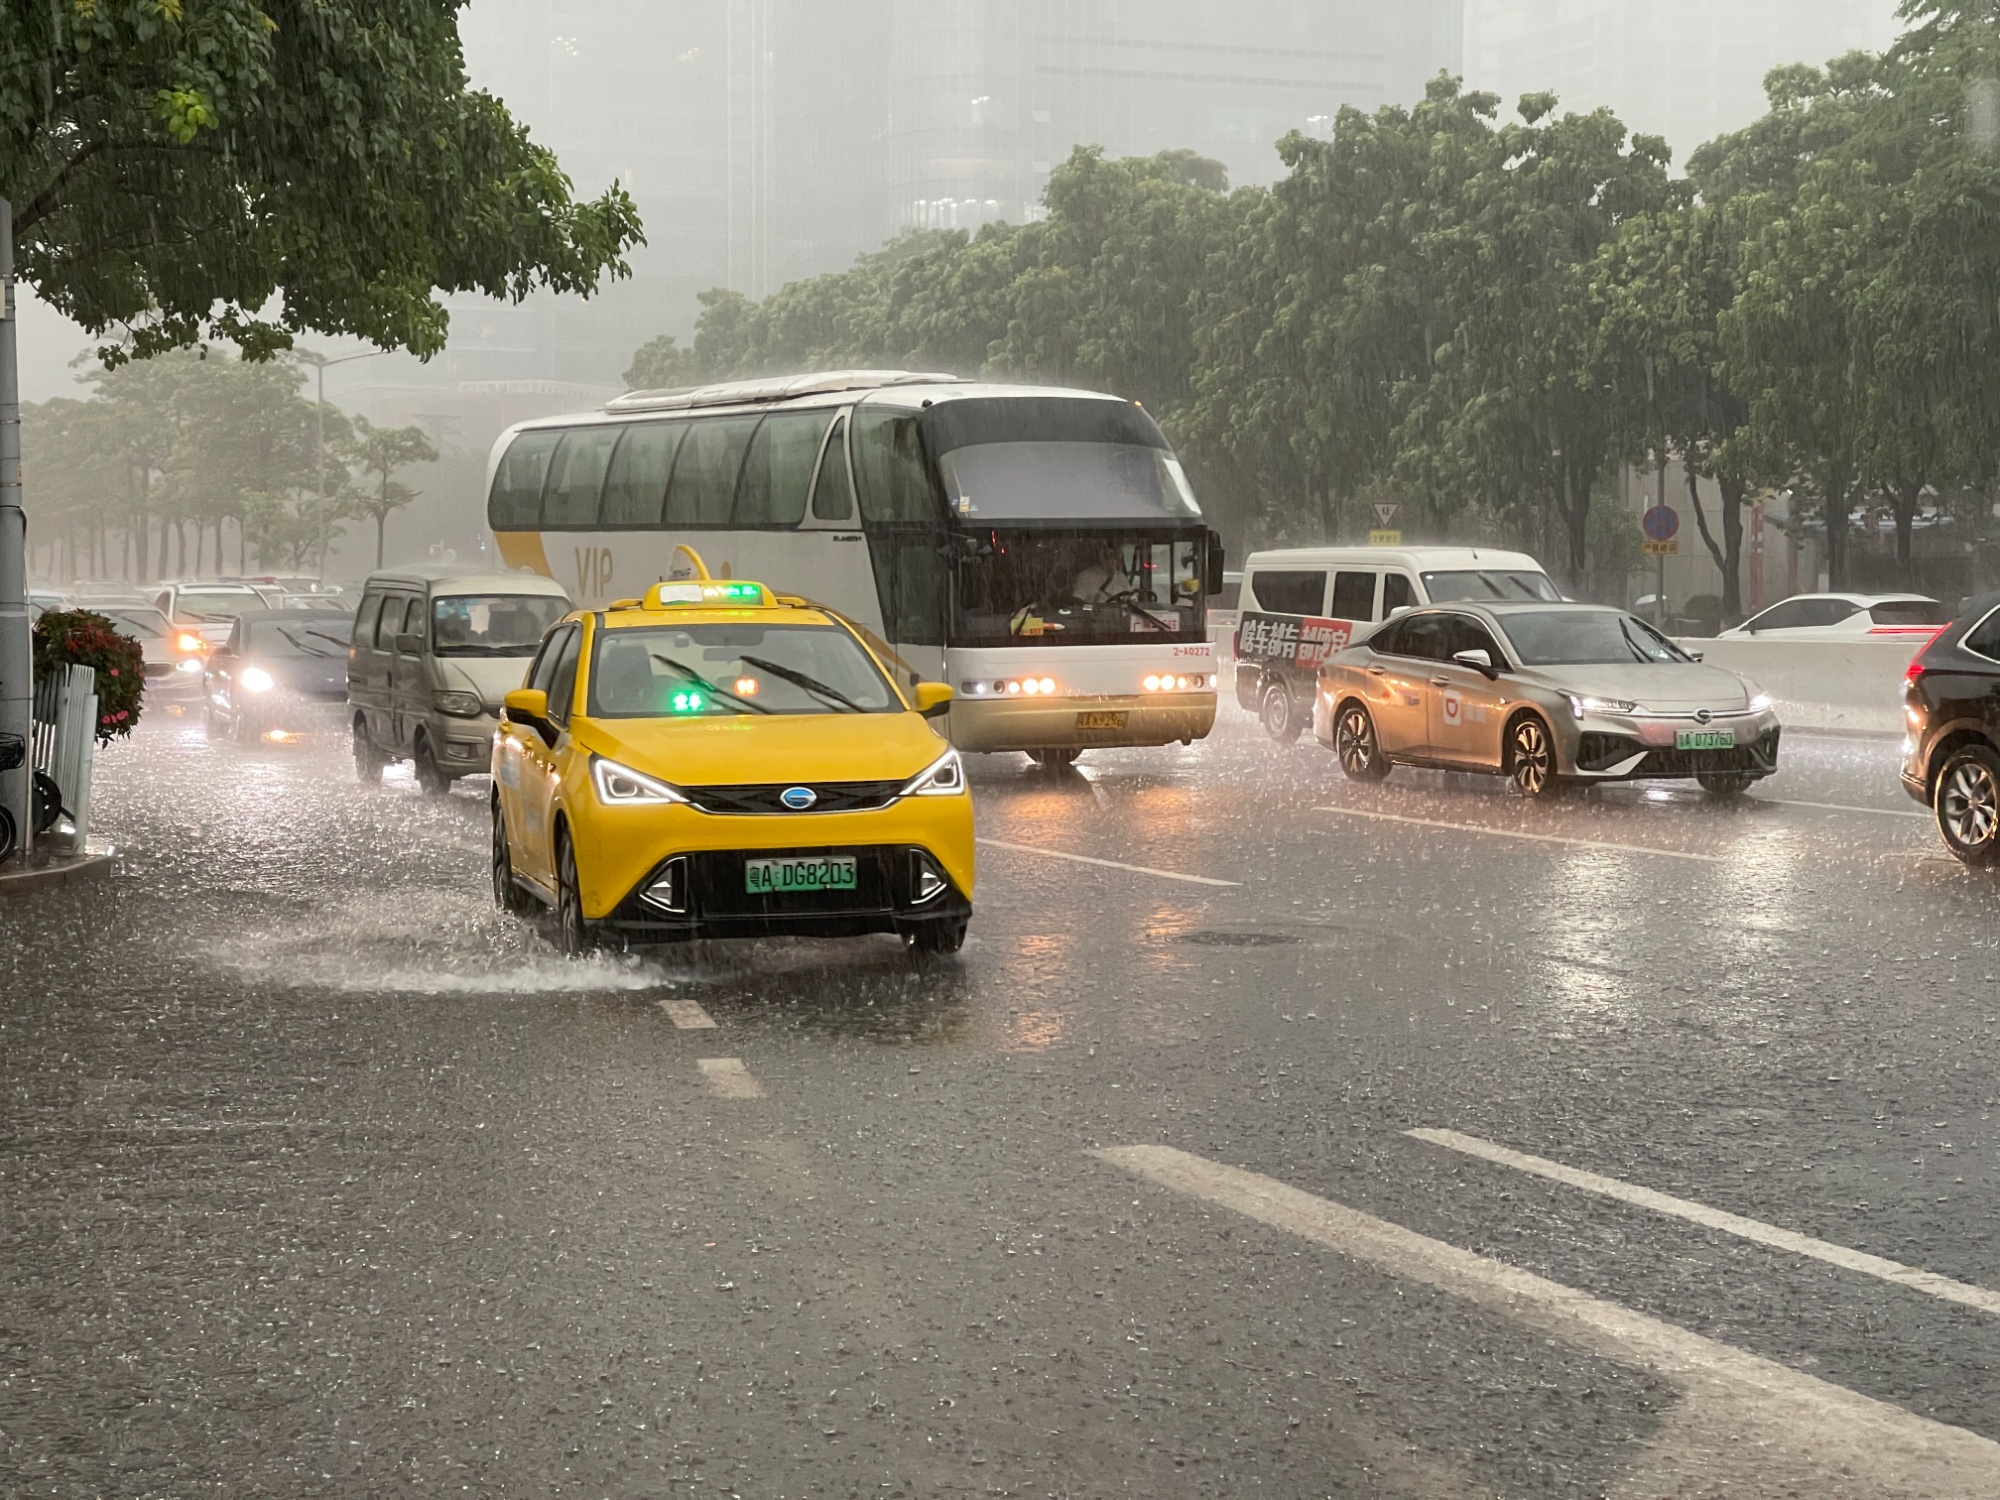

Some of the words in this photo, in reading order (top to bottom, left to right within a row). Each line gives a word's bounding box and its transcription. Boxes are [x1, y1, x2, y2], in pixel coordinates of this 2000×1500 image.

[575, 546, 613, 598] VIP
[1173, 647, 1210, 656] 2-A0272
[782, 862, 853, 886] DG8203
